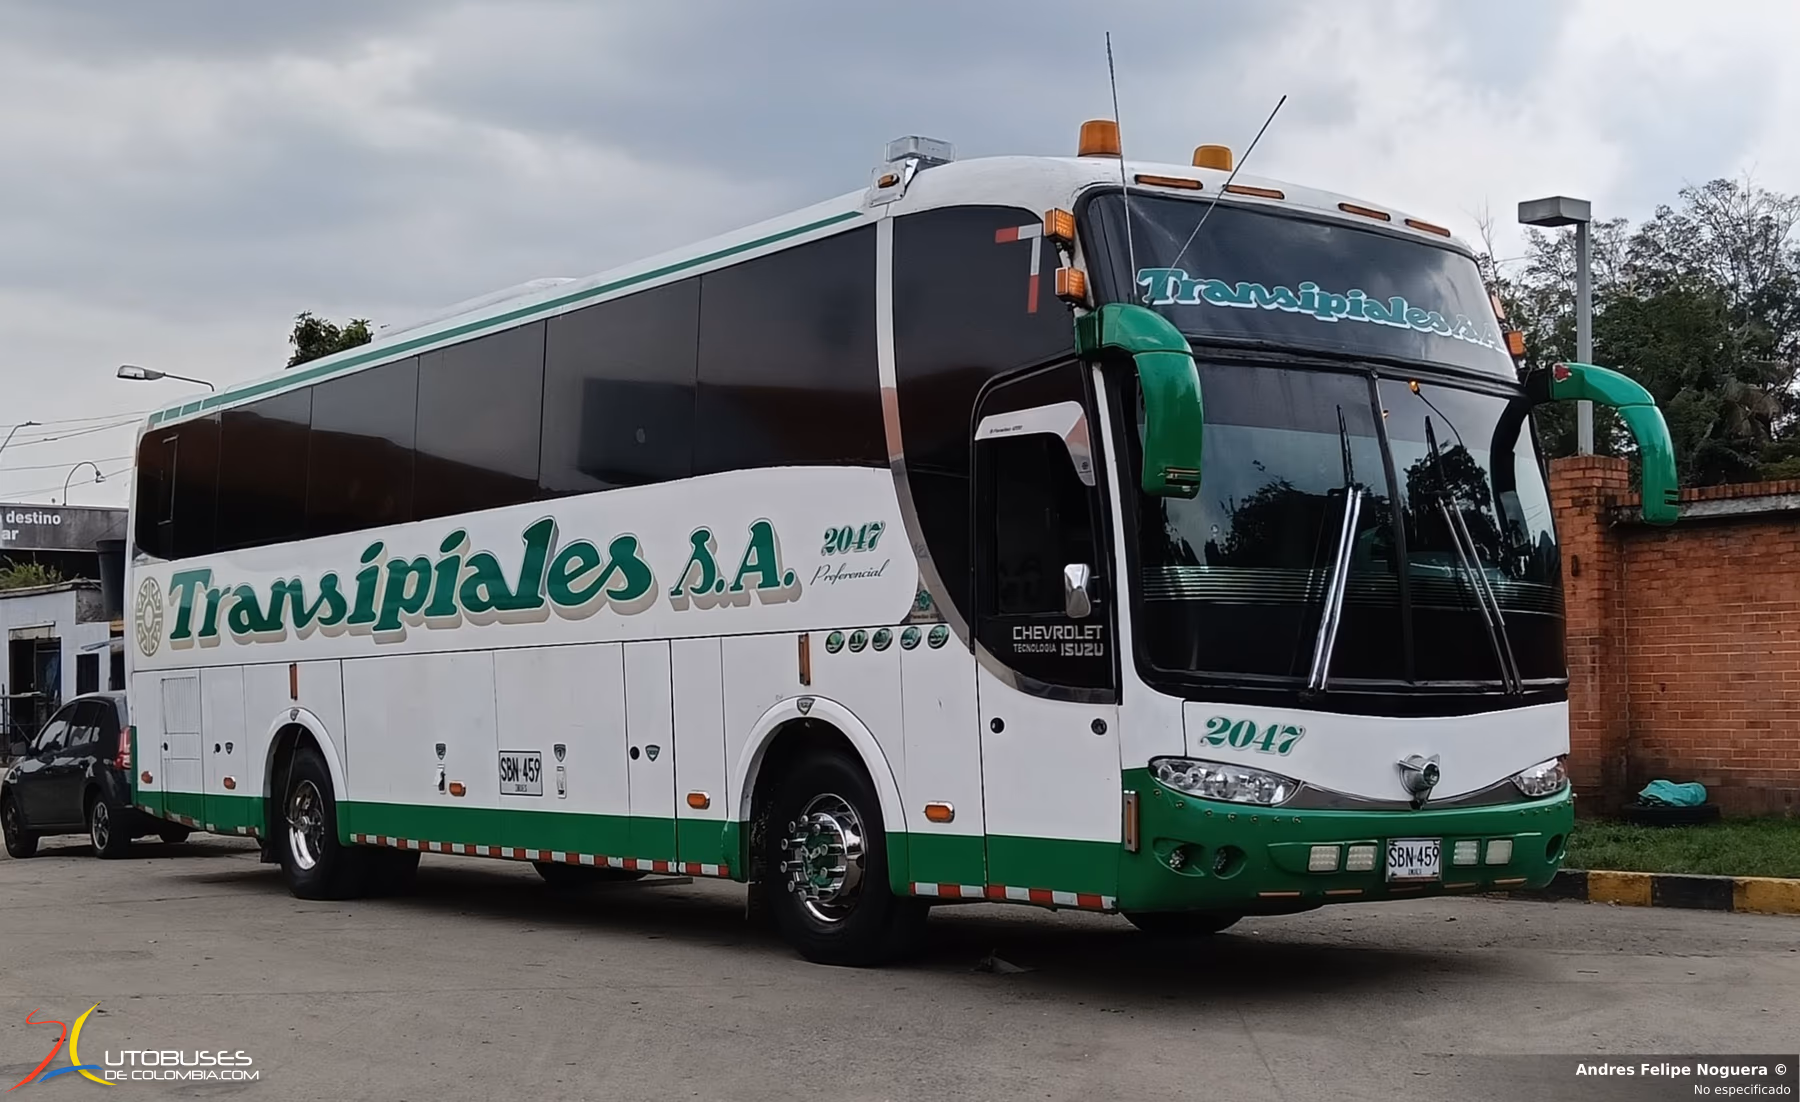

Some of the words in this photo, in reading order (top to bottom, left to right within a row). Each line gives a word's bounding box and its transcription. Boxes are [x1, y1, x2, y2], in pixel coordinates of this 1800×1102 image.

[1137, 268, 1452, 337] Transipiales
[6, 510, 61, 525] destino
[821, 521, 886, 556] 2047
[168, 515, 657, 644] Transipiales
[668, 518, 802, 611] S.A.
[810, 559, 890, 586] Preferencial
[1012, 625, 1103, 640] CHEVROLET
[1060, 643, 1104, 656] ISUZU
[1199, 716, 1306, 757] 2047
